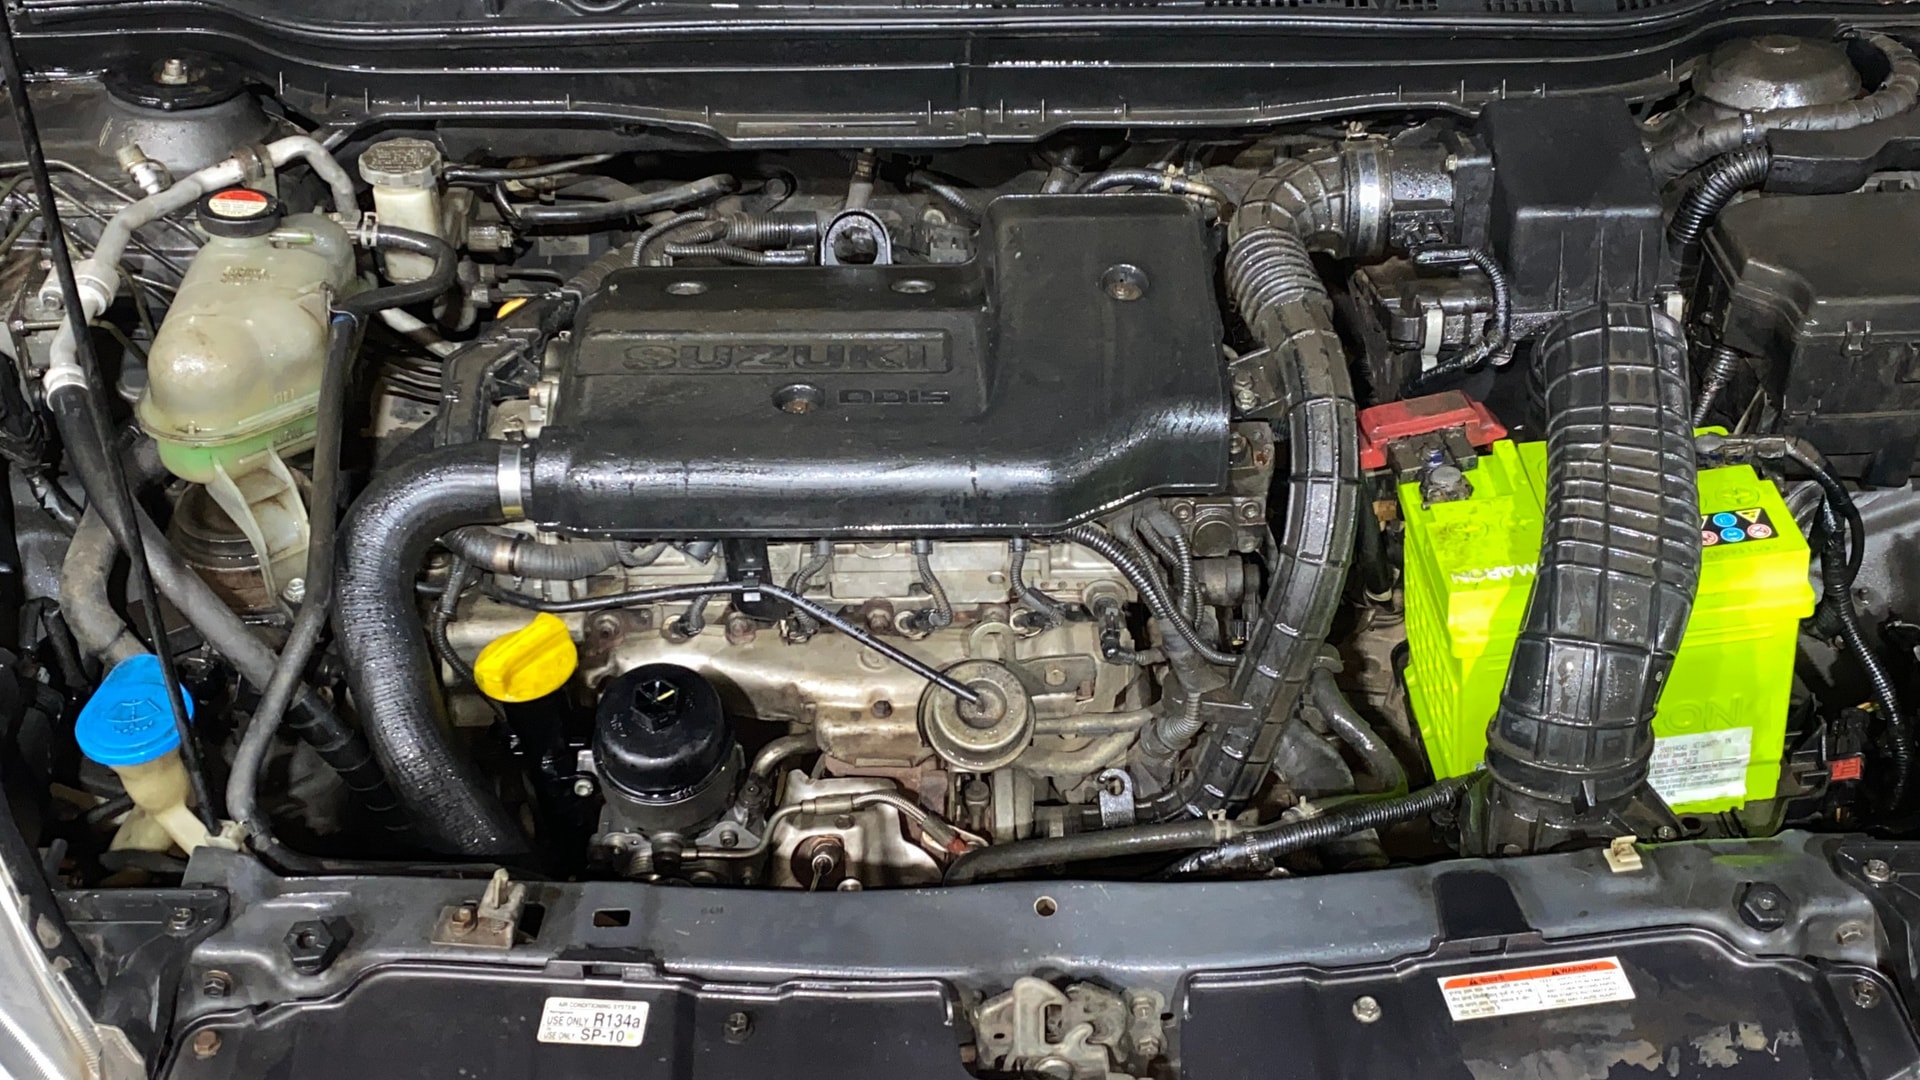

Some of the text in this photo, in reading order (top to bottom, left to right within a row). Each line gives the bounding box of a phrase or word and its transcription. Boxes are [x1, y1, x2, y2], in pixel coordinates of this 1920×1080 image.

[622, 343, 928, 371] SUZUKI
[1450, 562, 1537, 584] MARON
[546, 1011, 641, 1029] USE ONLY R134a
[543, 1027, 625, 1042] USE ONLY SP-10
